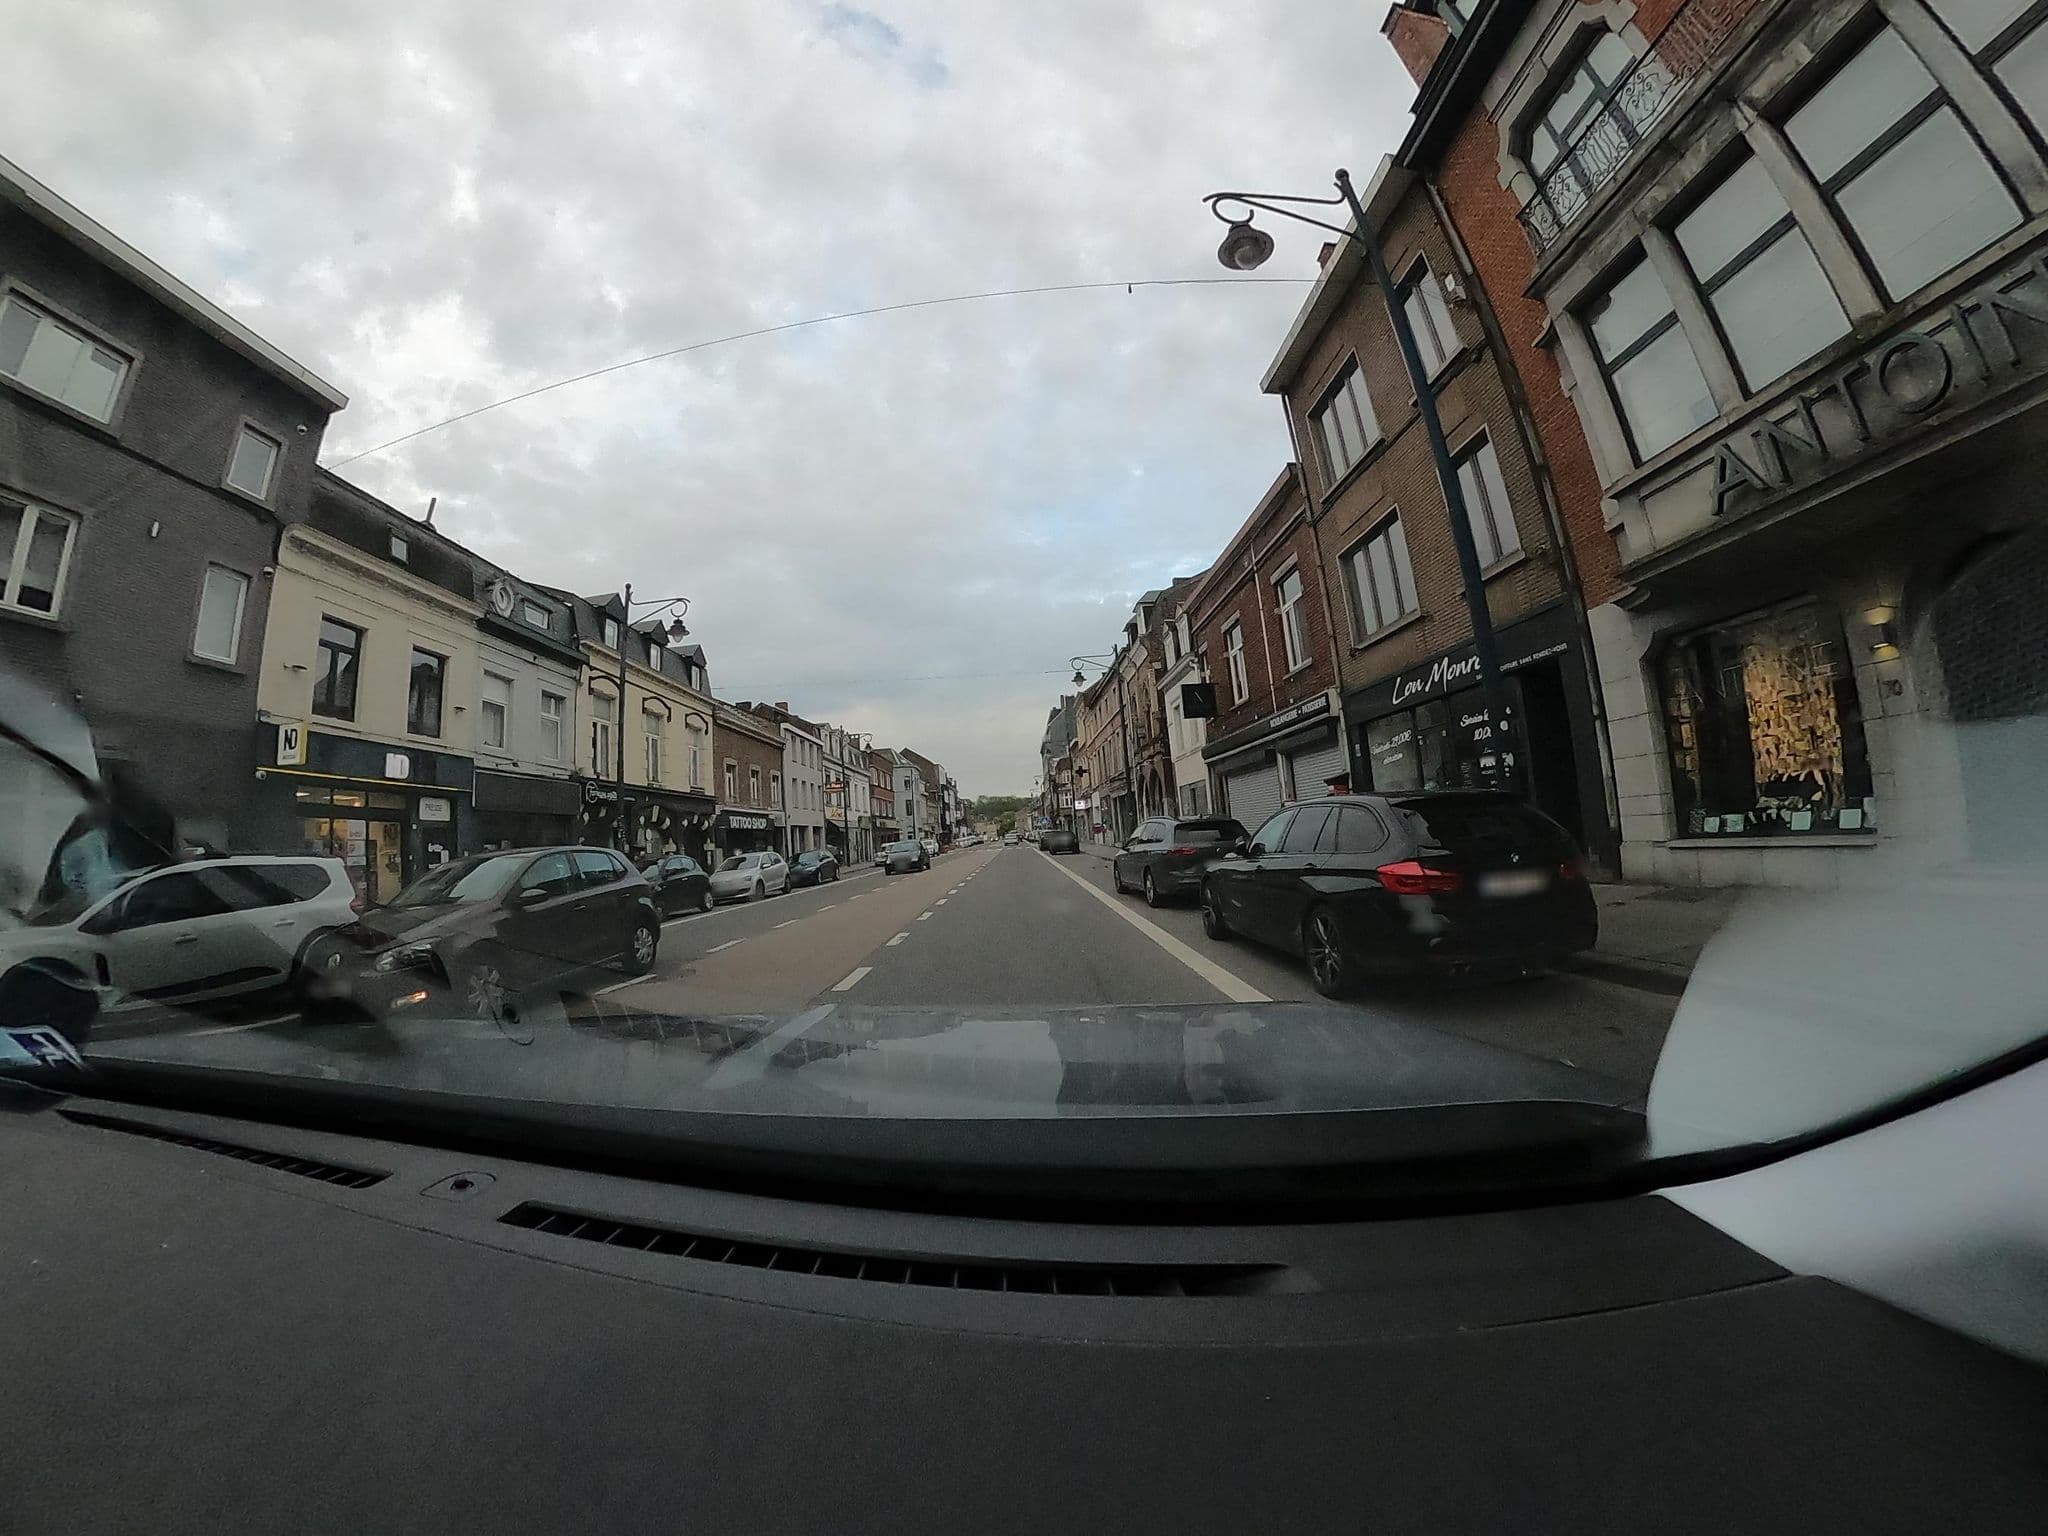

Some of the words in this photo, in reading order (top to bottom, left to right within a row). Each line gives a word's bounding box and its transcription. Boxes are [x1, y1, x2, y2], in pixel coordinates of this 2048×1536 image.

[283, 728, 298, 751] ND
[729, 816, 752, 830] TATTOO
[752, 817, 767, 830] SHOP
